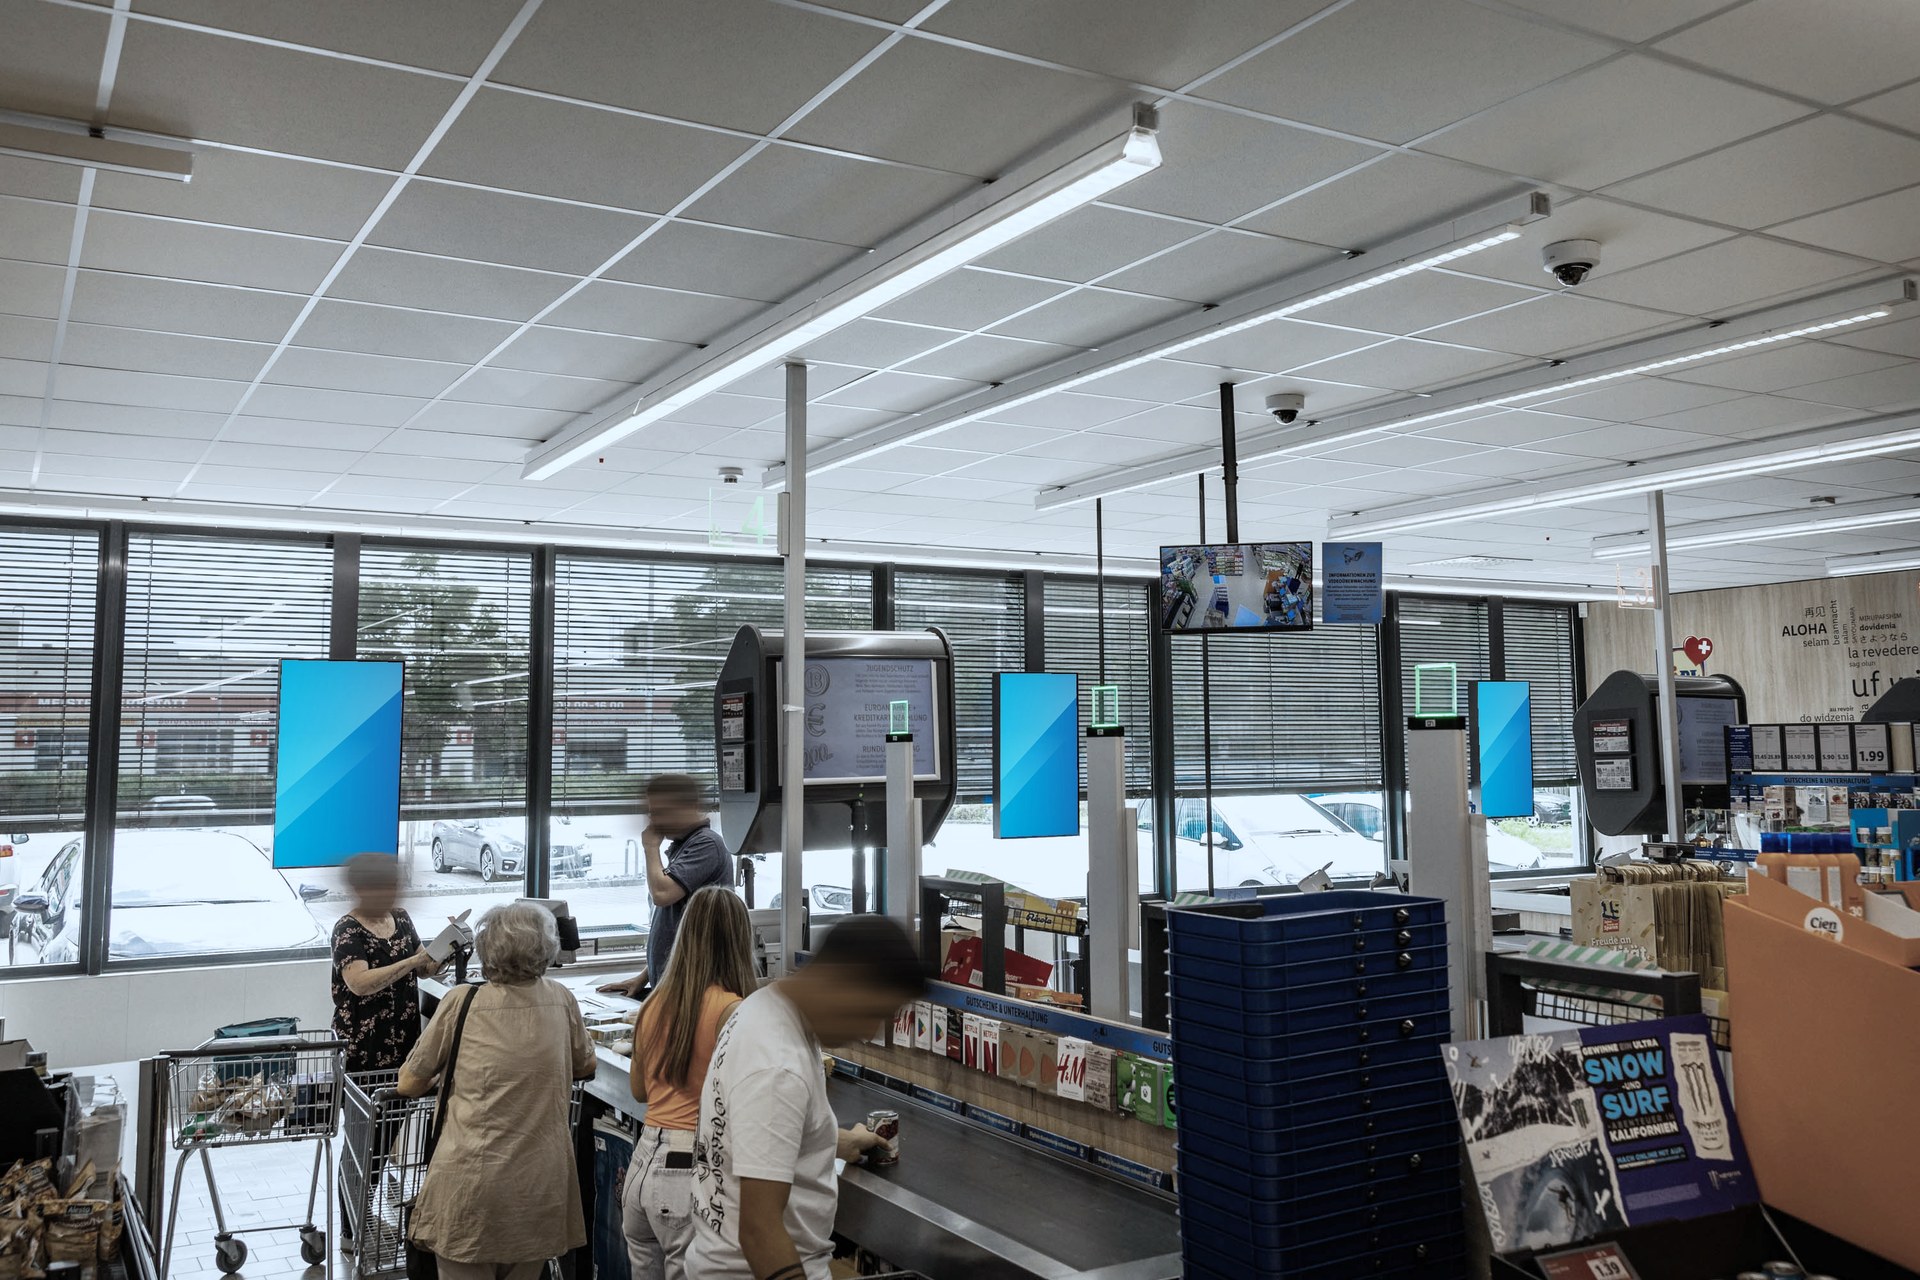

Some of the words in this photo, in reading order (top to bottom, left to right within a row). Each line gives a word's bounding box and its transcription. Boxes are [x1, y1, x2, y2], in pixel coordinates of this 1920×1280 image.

[1805, 605, 1826, 618] 再见
[1830, 600, 1840, 645] beannacht
[1860, 622, 1896, 631] dovidenia
[1782, 623, 1827, 637] ALOHA
[1803, 638, 1829, 647] selam
[1860, 633, 1908, 643] さようなら
[1848, 647, 1859, 658] la
[1863, 644, 1919, 658] revedere
[1800, 714, 1811, 722] do
[1814, 713, 1855, 722] widzenia
[1859, 751, 1884, 762] 1.99
[1825, 777, 1871, 785] UNTERHALTUNG
[1026, 912, 1053, 925] Ricola
[1810, 917, 1837, 931] Cien
[1591, 937, 1618, 946] Freude
[966, 995, 998, 1013] GUTSCHEINE
[1004, 1006, 1048, 1024] UNTERHALTUNG
[983, 1029, 998, 1040] NETFLIX
[1582, 1043, 1619, 1056] GEWINNE
[1632, 1038, 1659, 1048] ULTRA
[1057, 1053, 1086, 1088] H&M
[1584, 1050, 1664, 1084] SNOW
[1602, 1087, 1670, 1120] SURF
[1609, 1121, 1679, 1142] KALIFORNIEN
[1595, 1262, 1620, 1277] 1.39
